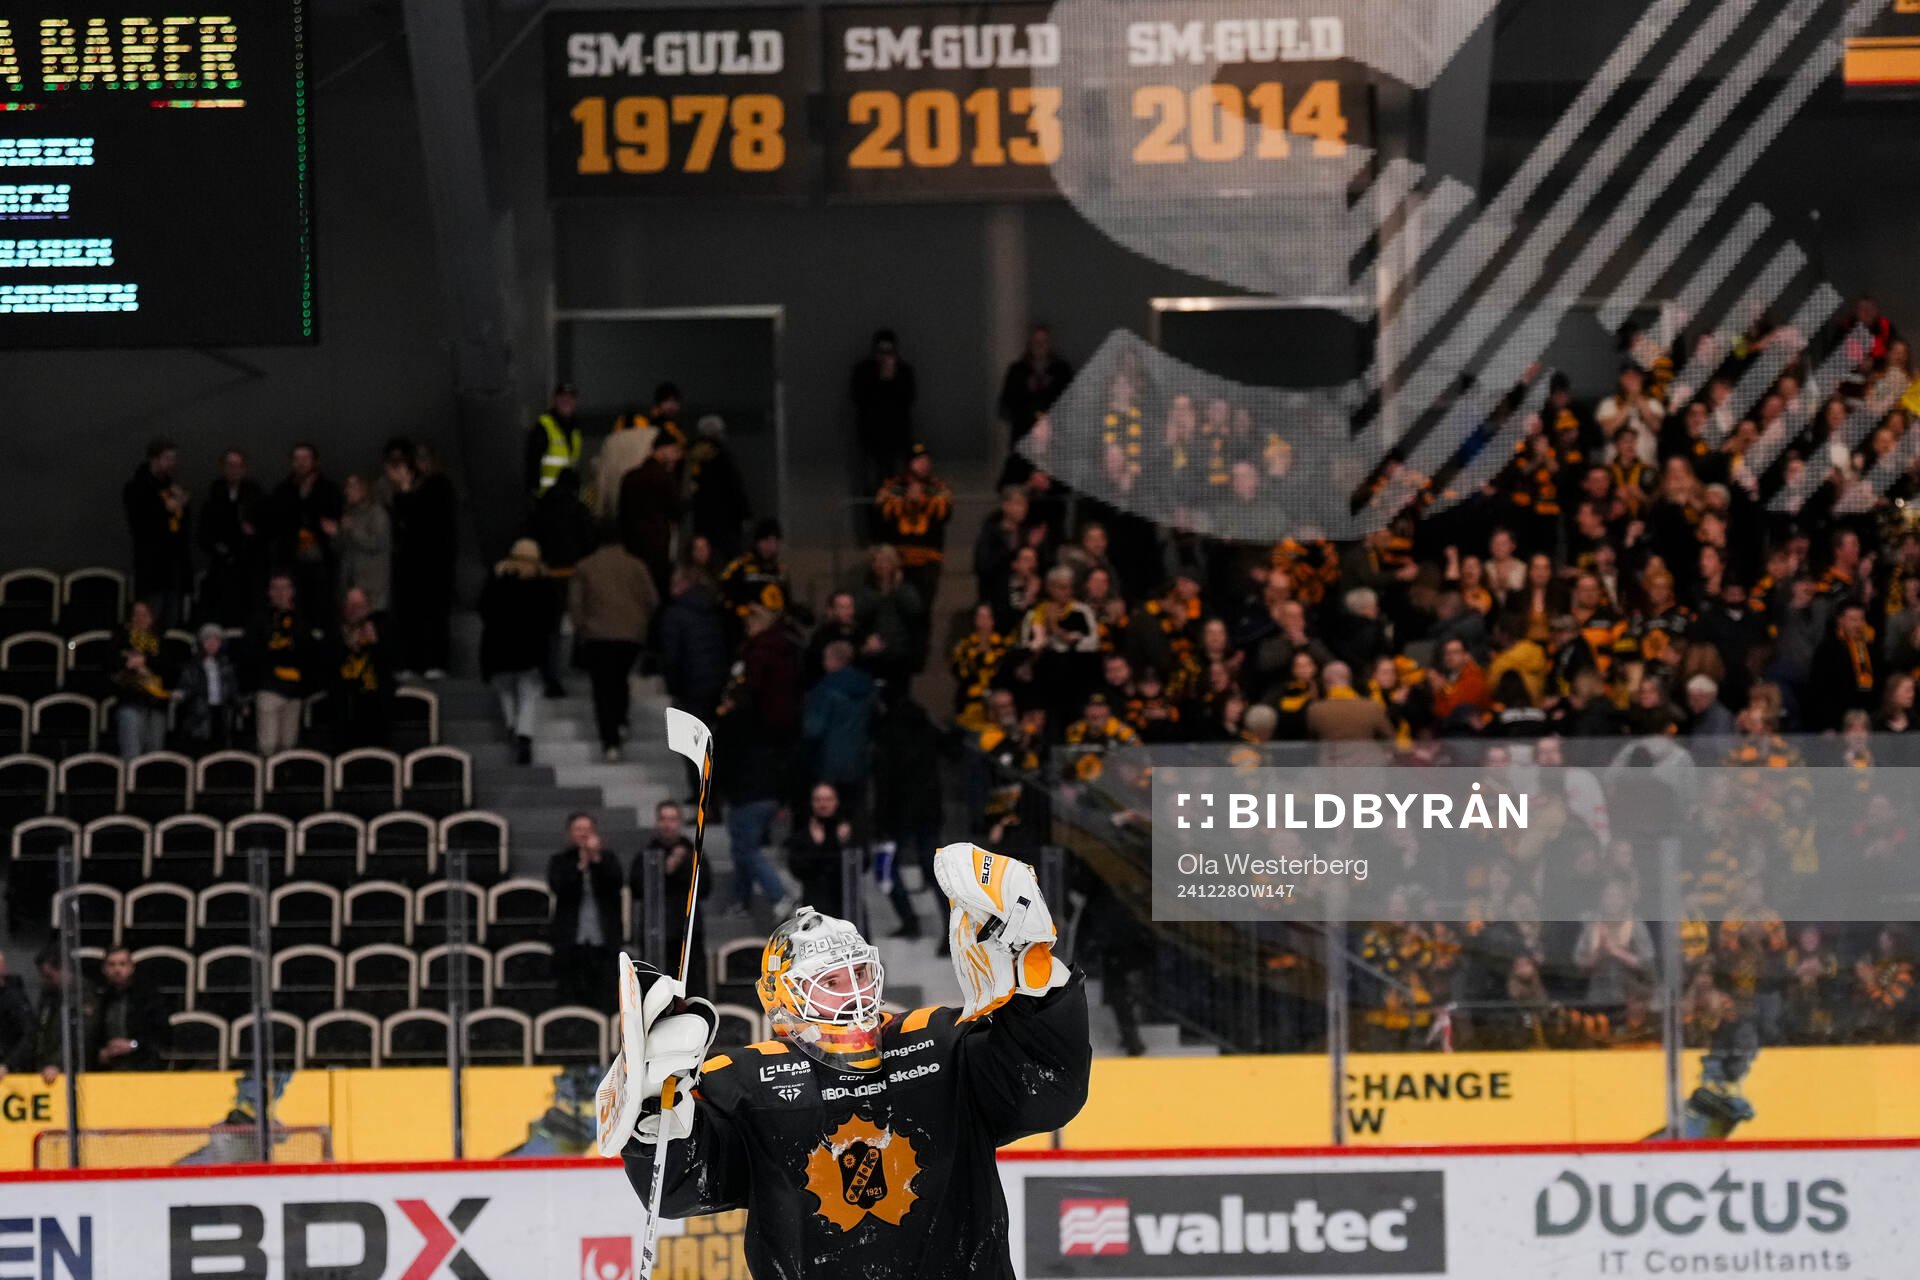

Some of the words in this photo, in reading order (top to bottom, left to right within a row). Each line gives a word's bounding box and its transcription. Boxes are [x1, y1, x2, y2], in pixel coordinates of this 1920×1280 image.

[567, 30, 784, 78] SM-GULD
[844, 23, 1061, 72] SM-GULD
[1127, 16, 1344, 67] SM-GULD
[568, 93, 786, 175] 1978
[847, 85, 1064, 170] 2013
[1131, 79, 1349, 165] 2014
[776, 1060, 811, 1073] LEAB
[791, 1068, 812, 1077] group
[838, 1074, 865, 1082] CCM
[888, 1062, 941, 1084] skebo
[2, 1093, 52, 1122] GE
[826, 1080, 888, 1101] BOLIDEN
[865, 1186, 883, 1197] 1921
[168, 1197, 492, 1280] BDX
[1134, 1194, 1409, 1256] valutec
[1600, 1251, 1630, 1276] IT
[1644, 1248, 1853, 1275] Consultants
